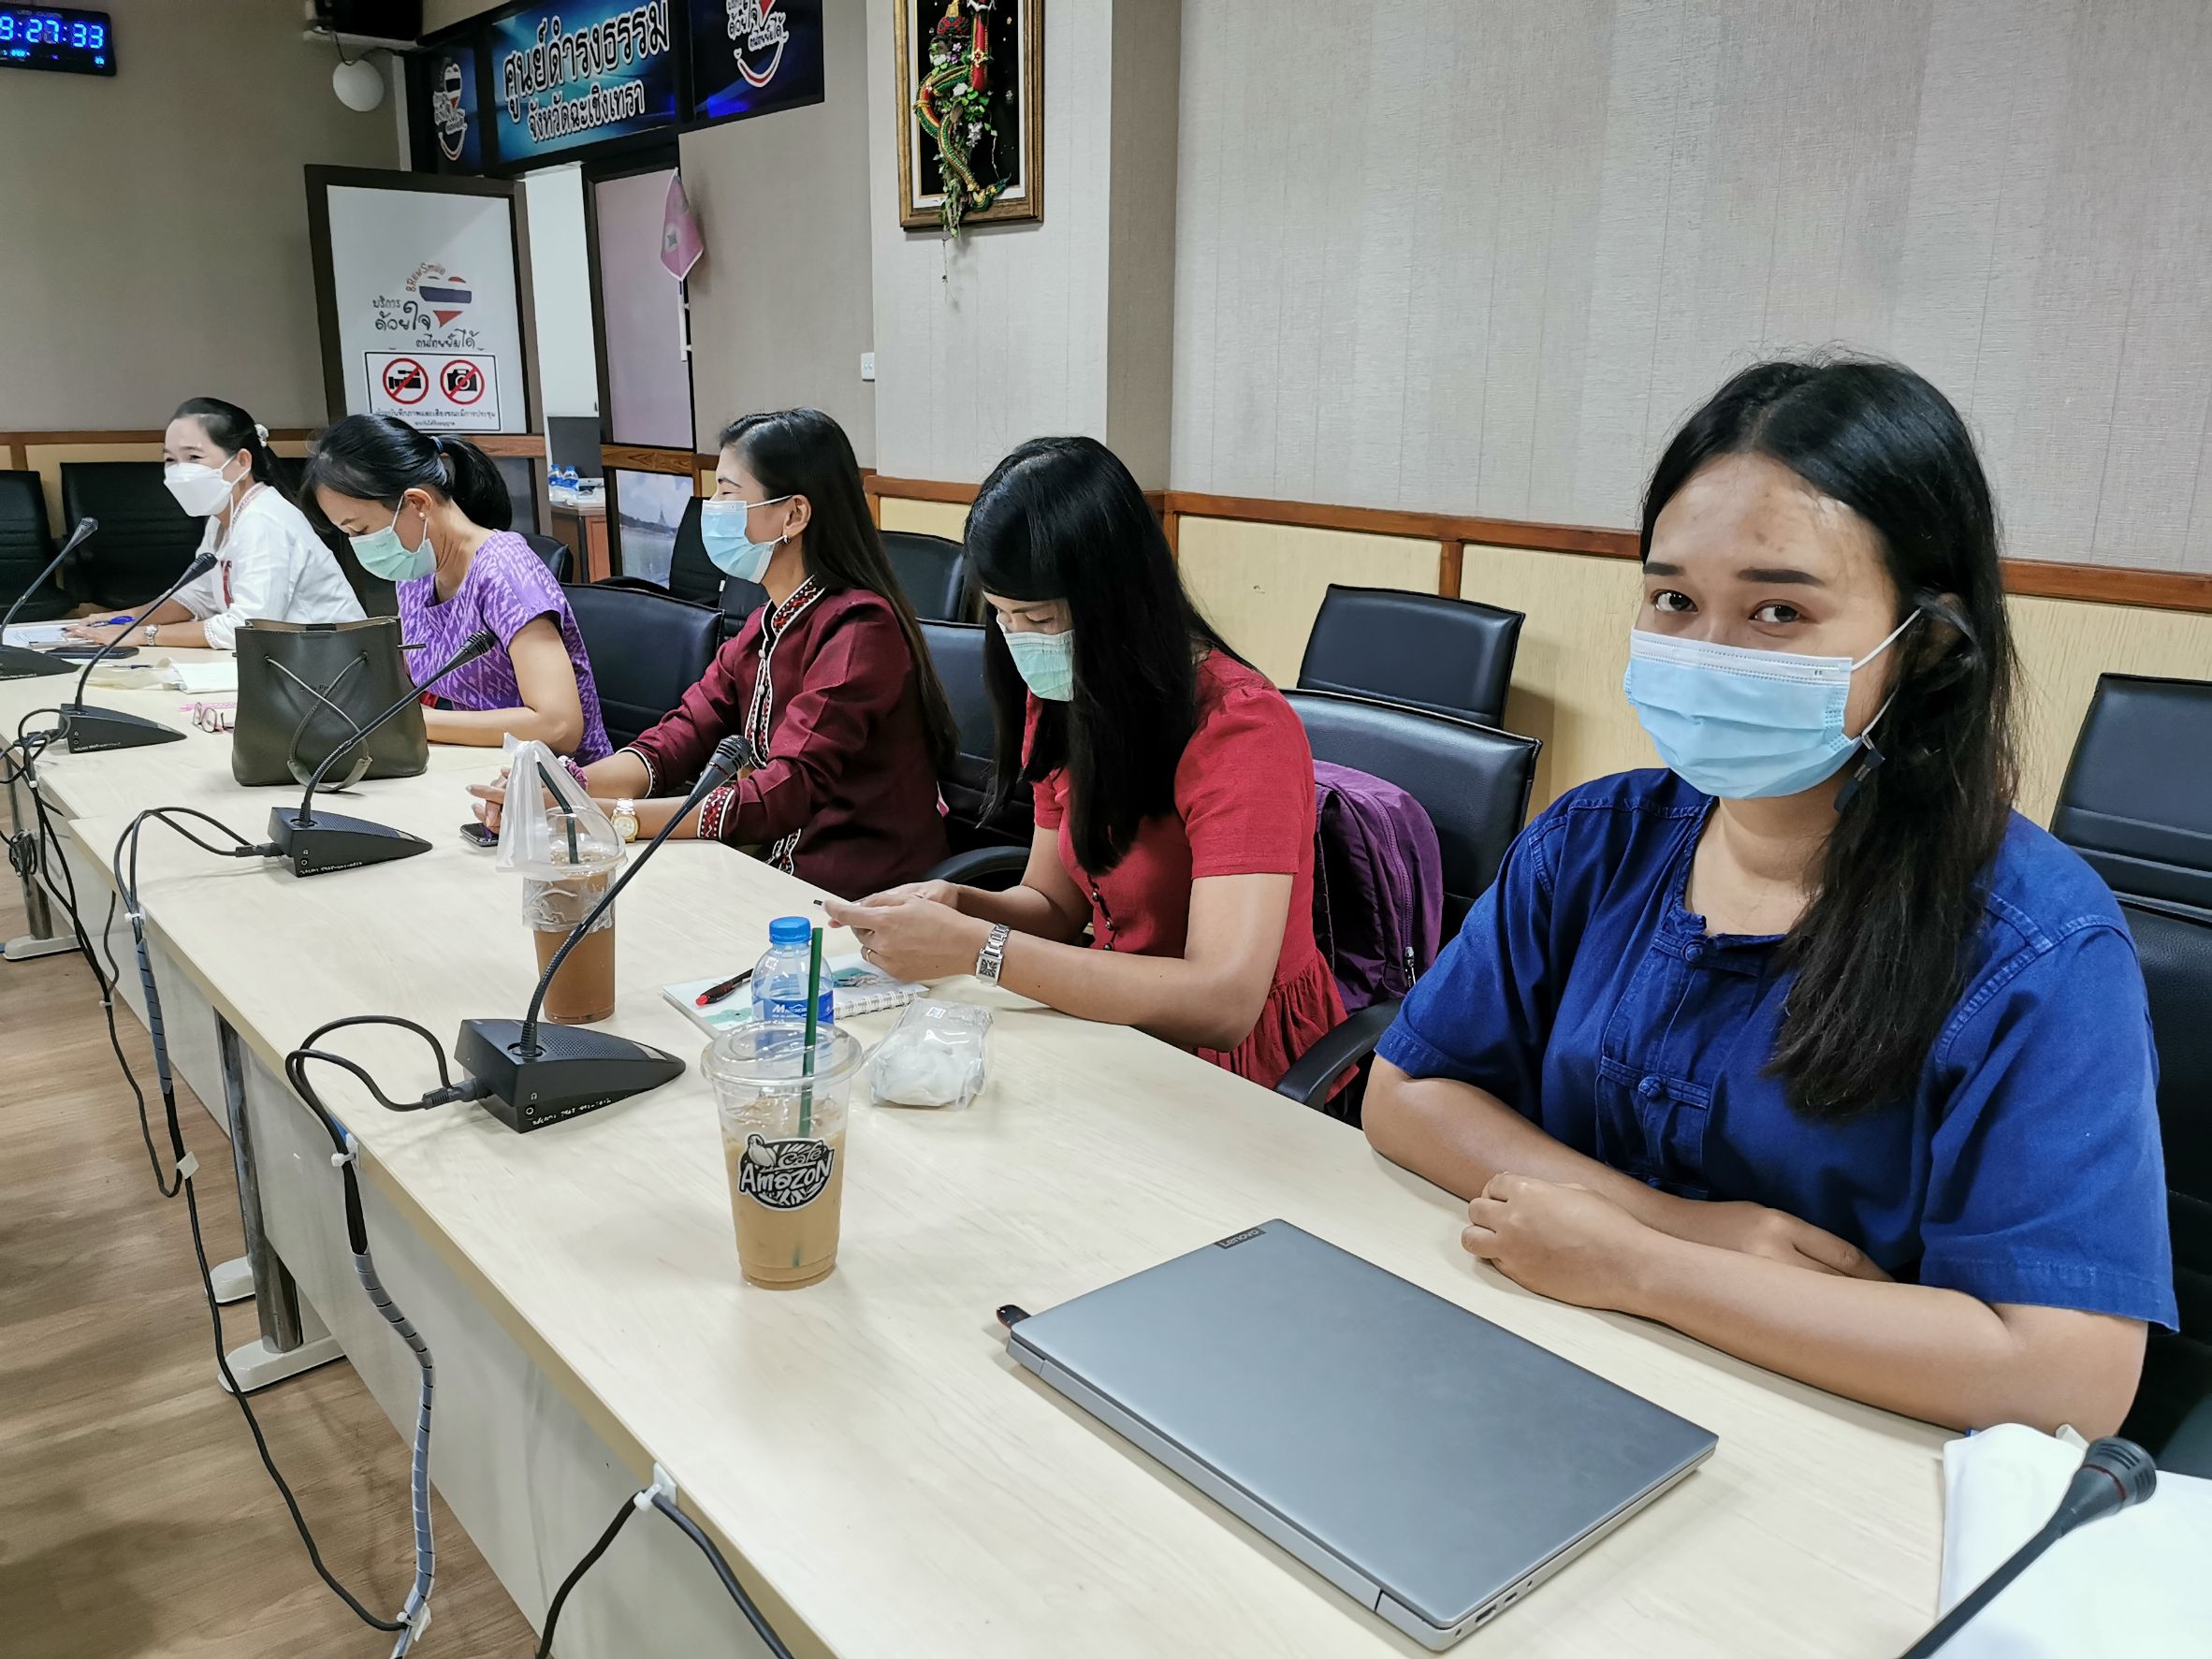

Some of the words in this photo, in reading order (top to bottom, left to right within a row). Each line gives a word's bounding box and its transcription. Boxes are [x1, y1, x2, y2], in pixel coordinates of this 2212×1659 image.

[503, 1, 670, 123] ศูนย์ดำรงธรรม
[528, 80, 646, 142] จังหวัดฉะเชิงเทรา
[372, 295, 401, 308] บริการ
[375, 300, 431, 331] ด้วยใจ
